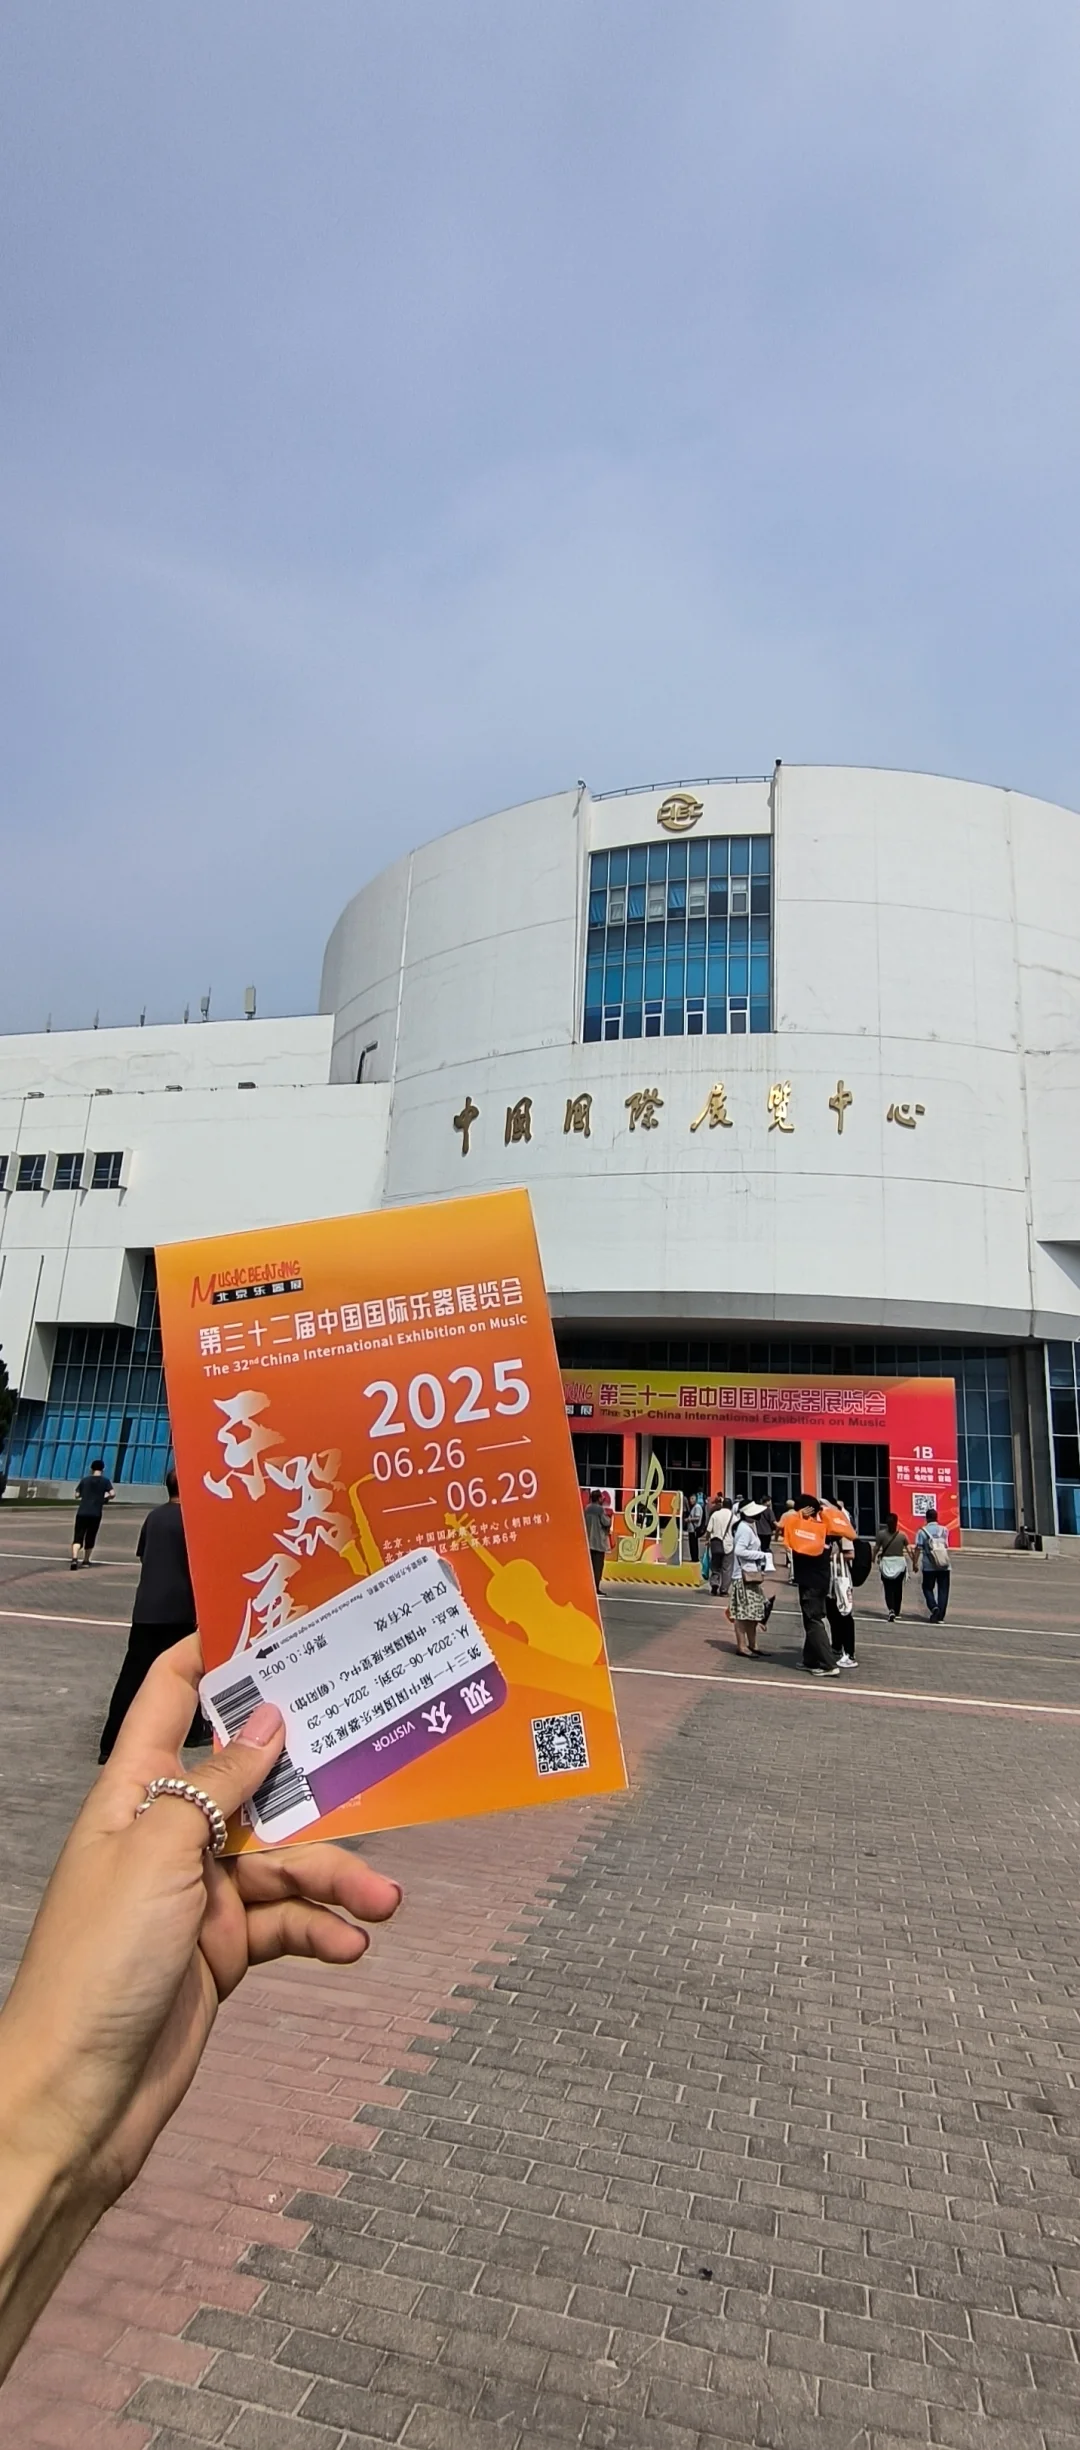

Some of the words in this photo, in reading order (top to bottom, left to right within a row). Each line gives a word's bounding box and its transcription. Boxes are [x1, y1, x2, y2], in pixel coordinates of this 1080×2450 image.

[199, 1277, 523, 1356] 第三十二届中国国际乐器展览会
[203, 1364, 230, 1377] The
[233, 1356, 259, 1373] 32nd
[260, 1352, 300, 1367] China
[303, 1335, 394, 1361] International
[397, 1324, 465, 1345] Exhibition
[469, 1321, 486, 1332] on
[489, 1314, 528, 1330] Music
[363, 1358, 531, 1438] 2025
[600, 1383, 886, 1415] 第三十一届中国国际乐器展览会
[600, 1408, 620, 1418] The
[623, 1408, 644, 1418] 31st
[647, 1409, 681, 1420] China
[685, 1411, 759, 1423] International
[763, 1414, 825, 1425] Exhibition
[829, 1417, 844, 1426] on
[849, 1417, 886, 1427] Music
[373, 1438, 465, 1482] 06.26
[913, 1446, 933, 1459] 1B
[446, 1468, 538, 1511] 06.29
[373, 1581, 446, 1632] 仅限一次有效
[307, 1685, 369, 1729] 2024-06-29
[311, 1644, 481, 1754] 第三十一届中国国际乐器展览会
[372, 1722, 415, 1751] VISITOR
